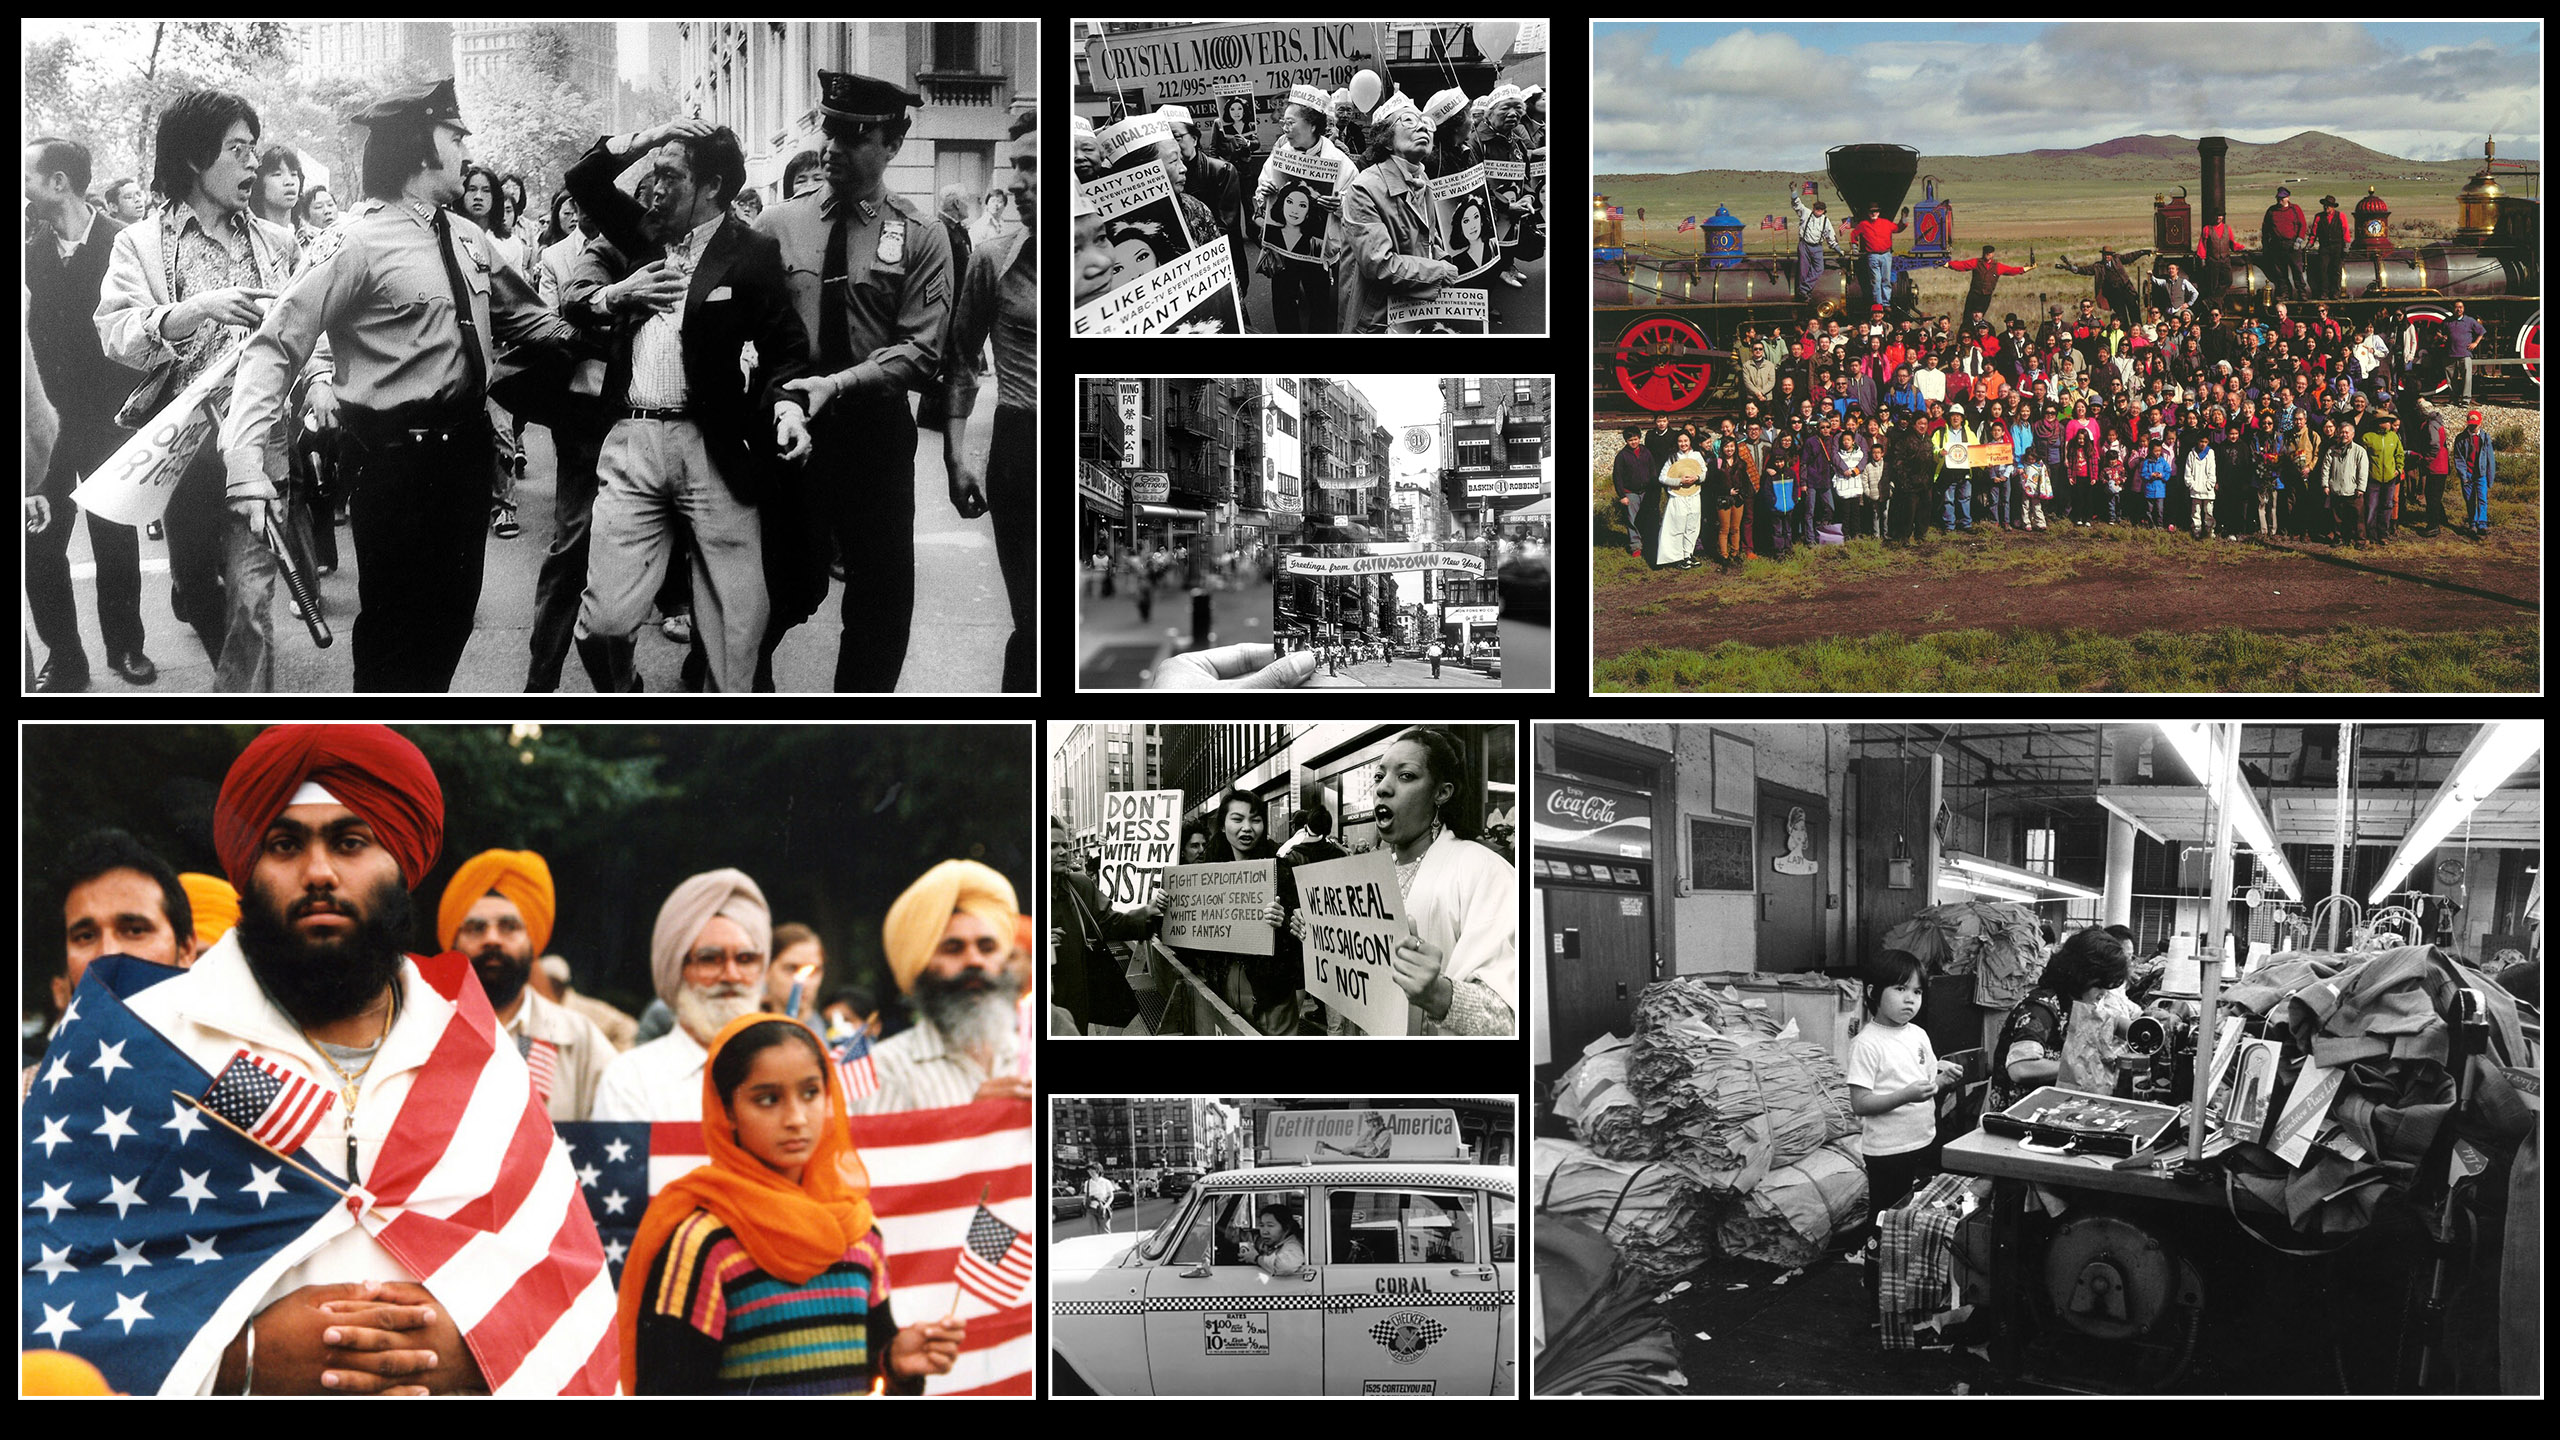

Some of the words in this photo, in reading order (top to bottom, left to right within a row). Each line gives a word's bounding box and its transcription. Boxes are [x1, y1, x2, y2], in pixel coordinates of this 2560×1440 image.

[1101, 42, 1189, 80] CRYSTAL
[1312, 22, 1360, 61] INC.
[1441, 98, 1460, 115] LOCAL
[1111, 127, 1144, 149] LOCAL
[1141, 120, 1169, 136] 23-25
[1284, 152, 1297, 160] LIKE
[1298, 156, 1318, 165] KAITY
[1320, 160, 1339, 168] TONG
[1127, 165, 1161, 182] TONG
[1273, 160, 1282, 169] WE
[1285, 164, 1307, 175] WANT
[1309, 170, 1338, 180] KAITY!
[1100, 181, 1146, 202] EYEWITNESS
[1147, 174, 1166, 184] NEWS
[1445, 176, 1460, 184] LIKE
[1120, 181, 1170, 208] KAITY!
[1433, 190, 1447, 199] WE
[1449, 184, 1471, 195] WANT
[1712, 235, 1728, 246] 60
[1101, 285, 1146, 320] LIKE
[1151, 260, 1192, 290] KAITY
[1195, 243, 1226, 265] TONG
[1120, 292, 1165, 324] WABC-TV
[1167, 264, 1211, 295] EYEWITNESS
[1212, 254, 1230, 268] NEWS
[1187, 264, 1232, 302] KAITY!
[1457, 292, 1484, 300] TONG
[1389, 310, 1405, 321] WE
[1408, 307, 1441, 317] WANT
[1445, 306, 1486, 319] KAITY!
[1120, 384, 1139, 394] WING
[1123, 395, 1136, 405] FAT
[1468, 484, 1494, 492] BASKIN
[1509, 482, 1539, 491] ROBBINS
[1289, 560, 1327, 571] Greetings
[1328, 563, 1350, 573] from
[1353, 554, 1439, 572] CHINATOWN
[1442, 557, 1460, 566] New
[1461, 557, 1483, 571] York
[1566, 786, 1585, 797] Enjoy
[1108, 793, 1178, 820] DON'T
[1547, 789, 1618, 823] Coca-Cola
[1105, 819, 1170, 841] MESS
[1104, 843, 1141, 861] WITH
[1147, 843, 1175, 863] MY
[1787, 855, 1804, 865] LADY
[1102, 863, 1162, 904] SISTE
[1169, 873, 1198, 890] FIGHT
[1201, 869, 1267, 886] EXPLOITATION
[1229, 891, 1264, 904] SERVES
[1305, 886, 1323, 916] WE
[1323, 886, 1347, 916] ARE
[1345, 883, 1394, 920] REAL
[1170, 910, 1197, 921] WHITE
[1201, 908, 1229, 921] MAN'S
[1231, 908, 1264, 921] GREED
[1169, 925, 1187, 936] AND
[1192, 925, 1232, 938] FANTASY
[1315, 955, 1328, 983] IS
[1335, 965, 1369, 1006] NOT
[2304, 1094, 2326, 1111] Place
[1274, 1115, 1303, 1137] Get
[1304, 1116, 1315, 1137] it
[1316, 1115, 1354, 1137] done
[1386, 1113, 1452, 1136] America
[1375, 1277, 1432, 1293] CORAL
[1391, 1312, 1426, 1328] CHECKER
[1365, 1385, 1381, 1393] 1525
[1381, 1384, 1421, 1393] CORTELYOU
